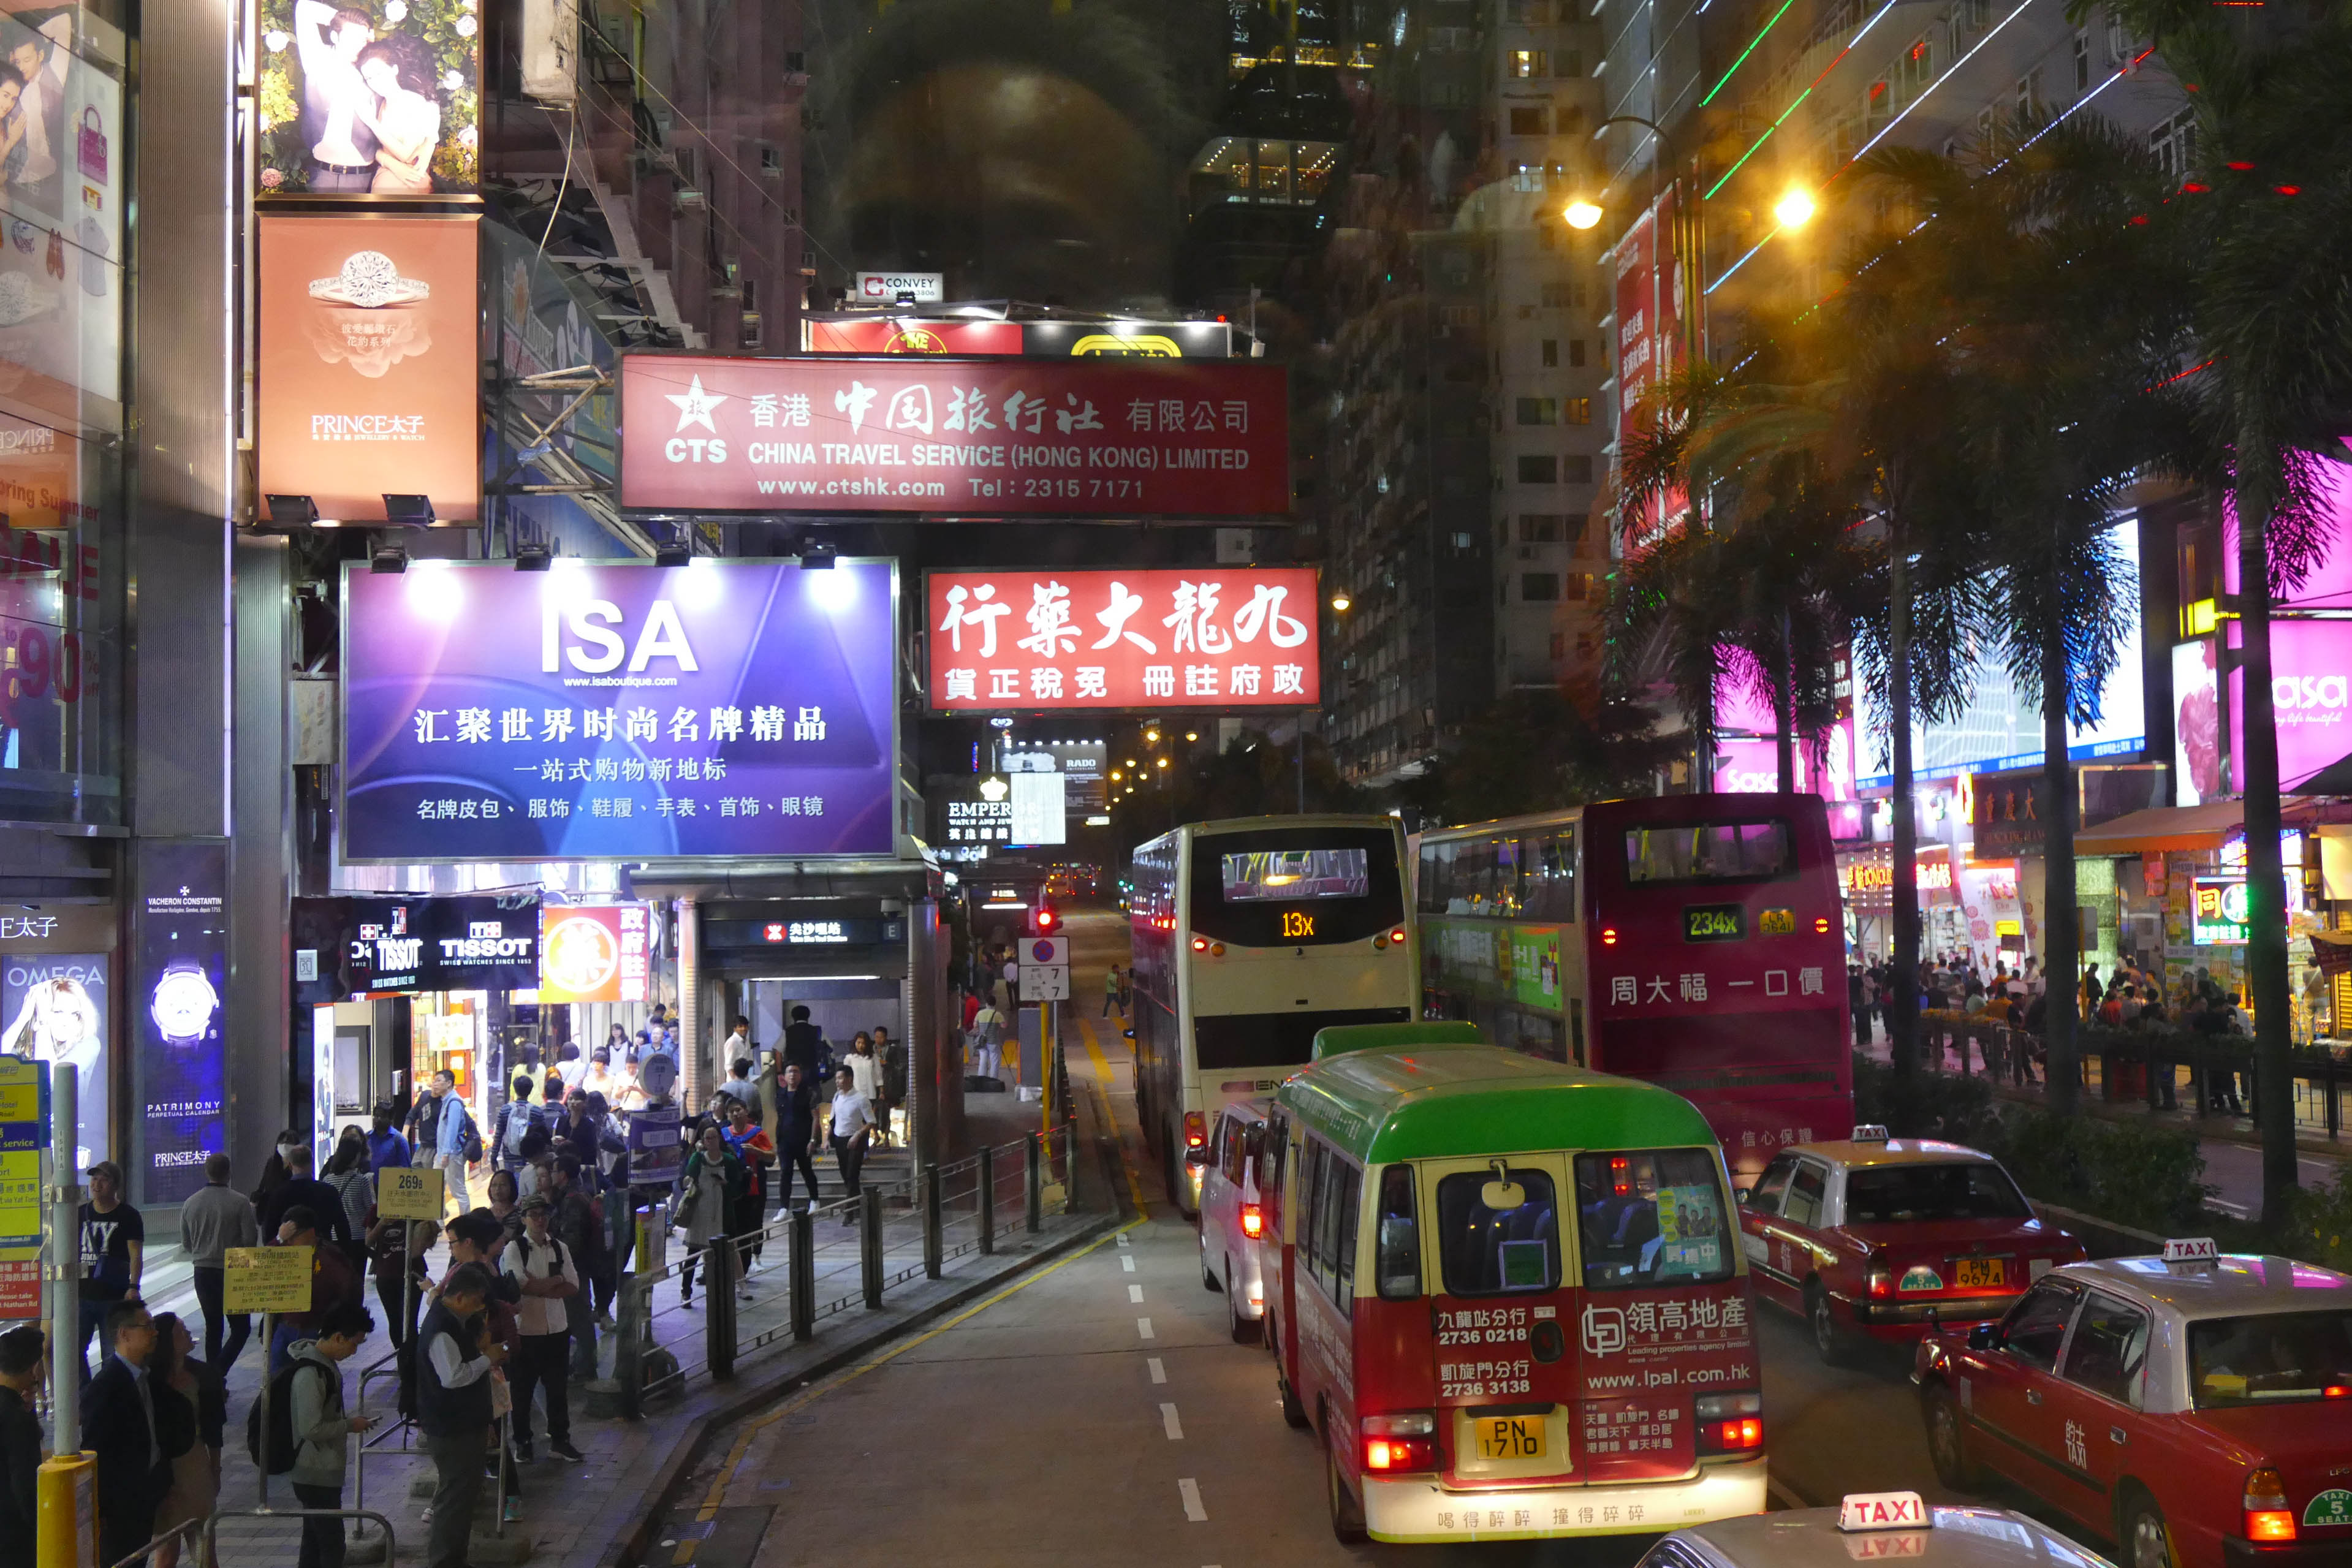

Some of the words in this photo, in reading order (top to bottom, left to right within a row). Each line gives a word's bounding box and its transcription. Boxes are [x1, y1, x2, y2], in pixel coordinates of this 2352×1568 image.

[886, 278, 935, 287] CONVEY
[749, 393, 812, 427] 香港
[1126, 397, 1248, 434] 有限公司
[665, 438, 727, 463] CTS
[748, 442, 816, 464] CHINA
[821, 443, 906, 466] TRAVEL
[911, 444, 1005, 467] SERVICE
[1011, 445, 1082, 469] (HONG
[1088, 445, 1159, 471] KONG)
[1166, 448, 1250, 470] LIMITED
[757, 477, 945, 496] www.ctshk.com
[1024, 479, 1080, 498] 2315
[1089, 480, 1143, 498] 7171
[541, 599, 699, 673] ISA
[563, 675, 677, 687] www.isaboutique.com
[2272, 675, 2348, 709] asa
[414, 705, 827, 744] 汇聚世界时尚名牌精品
[513, 757, 727, 782] 一站式购物新地标
[1985, 789, 2038, 822] 重慶大
[148, 897, 182, 906] VACHERON
[183, 896, 222, 905] CONSTANTIN
[889, 925, 895, 937] E
[376, 938, 423, 971] TISSOT
[439, 938, 532, 957] TISSOT
[7, 965, 104, 987] OMEGA
[1052, 968, 1059, 979] 7
[1052, 986, 1060, 997] 7
[1611, 973, 1708, 1006] 周大福
[148, 1101, 220, 1112] PATRIMONY
[1857, 1128, 1883, 1138] TAXI
[4, 1139, 34, 1148] service
[2174, 1242, 2215, 1256] TAXI
[1970, 1260, 1990, 1274] PM
[1960, 1273, 2001, 1286] 9674
[1438, 1307, 1527, 1329] 九龍站分行
[1626, 1295, 1748, 1333] 領高地產
[1440, 1330, 1481, 1345] 2736
[1485, 1328, 1527, 1343] 0218
[1628, 1347, 1658, 1355] Leading
[1660, 1345, 1698, 1354] properties
[1699, 1343, 1726, 1352] agency
[1441, 1360, 1530, 1381] 凱旋門分行
[1442, 1382, 1484, 1397] 2736
[1489, 1380, 1530, 1395] 3138
[1494, 1420, 1526, 1437] PN
[2066, 1418, 2085, 1446] 的士
[1484, 1437, 1538, 1456] 1710
[2066, 1439, 2087, 1470] TAXI
[2322, 1492, 2350, 1501] TAXI
[1855, 1500, 1919, 1523] TAXI
[2331, 1501, 2343, 1514] 5
